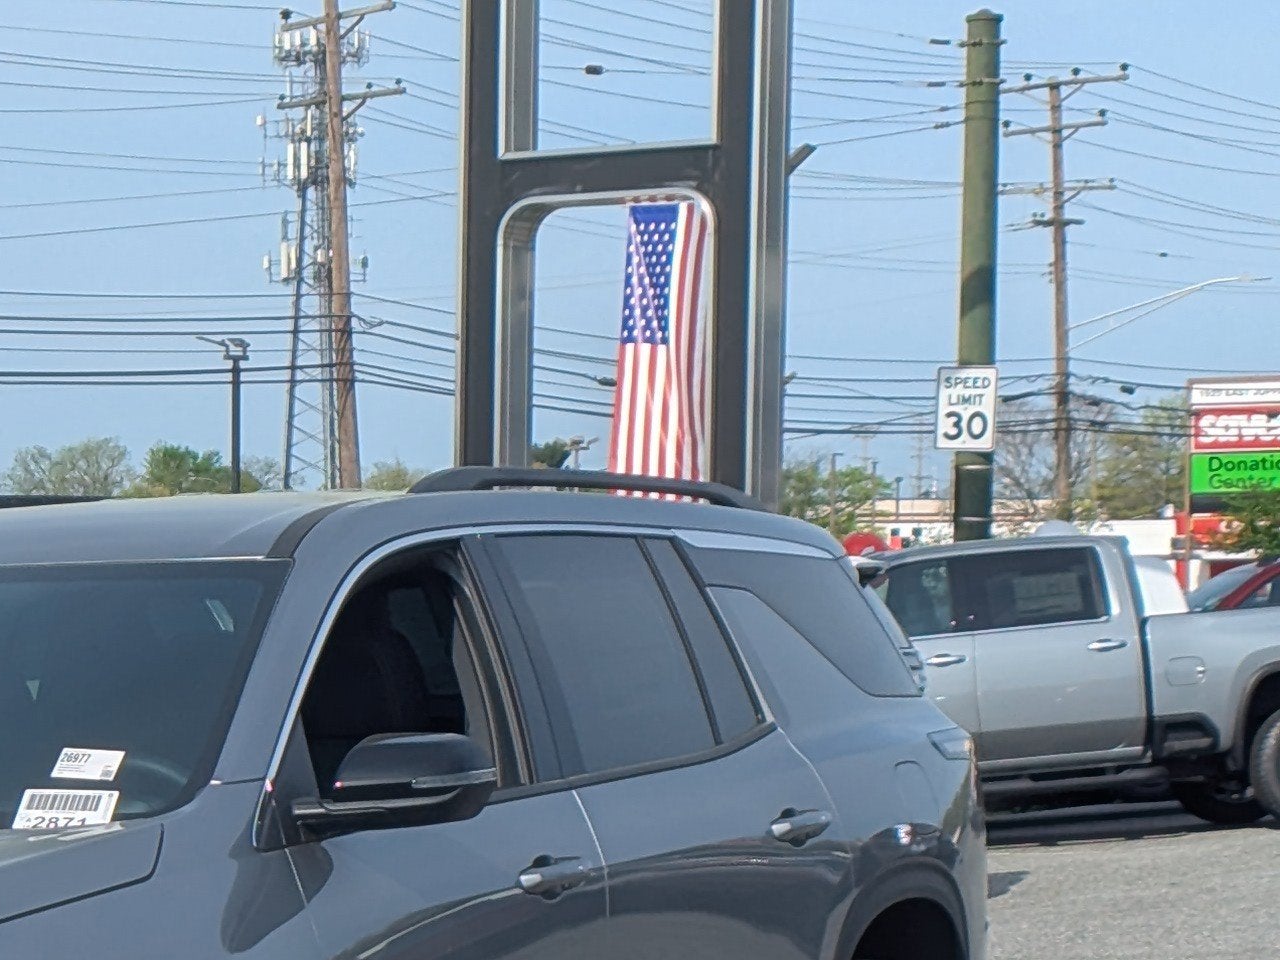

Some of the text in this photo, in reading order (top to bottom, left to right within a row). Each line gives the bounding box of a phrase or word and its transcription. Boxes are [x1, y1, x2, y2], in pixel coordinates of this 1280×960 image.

[944, 376, 991, 389] SPEED
[948, 393, 985, 406] LIMIT
[942, 410, 988, 440] 30
